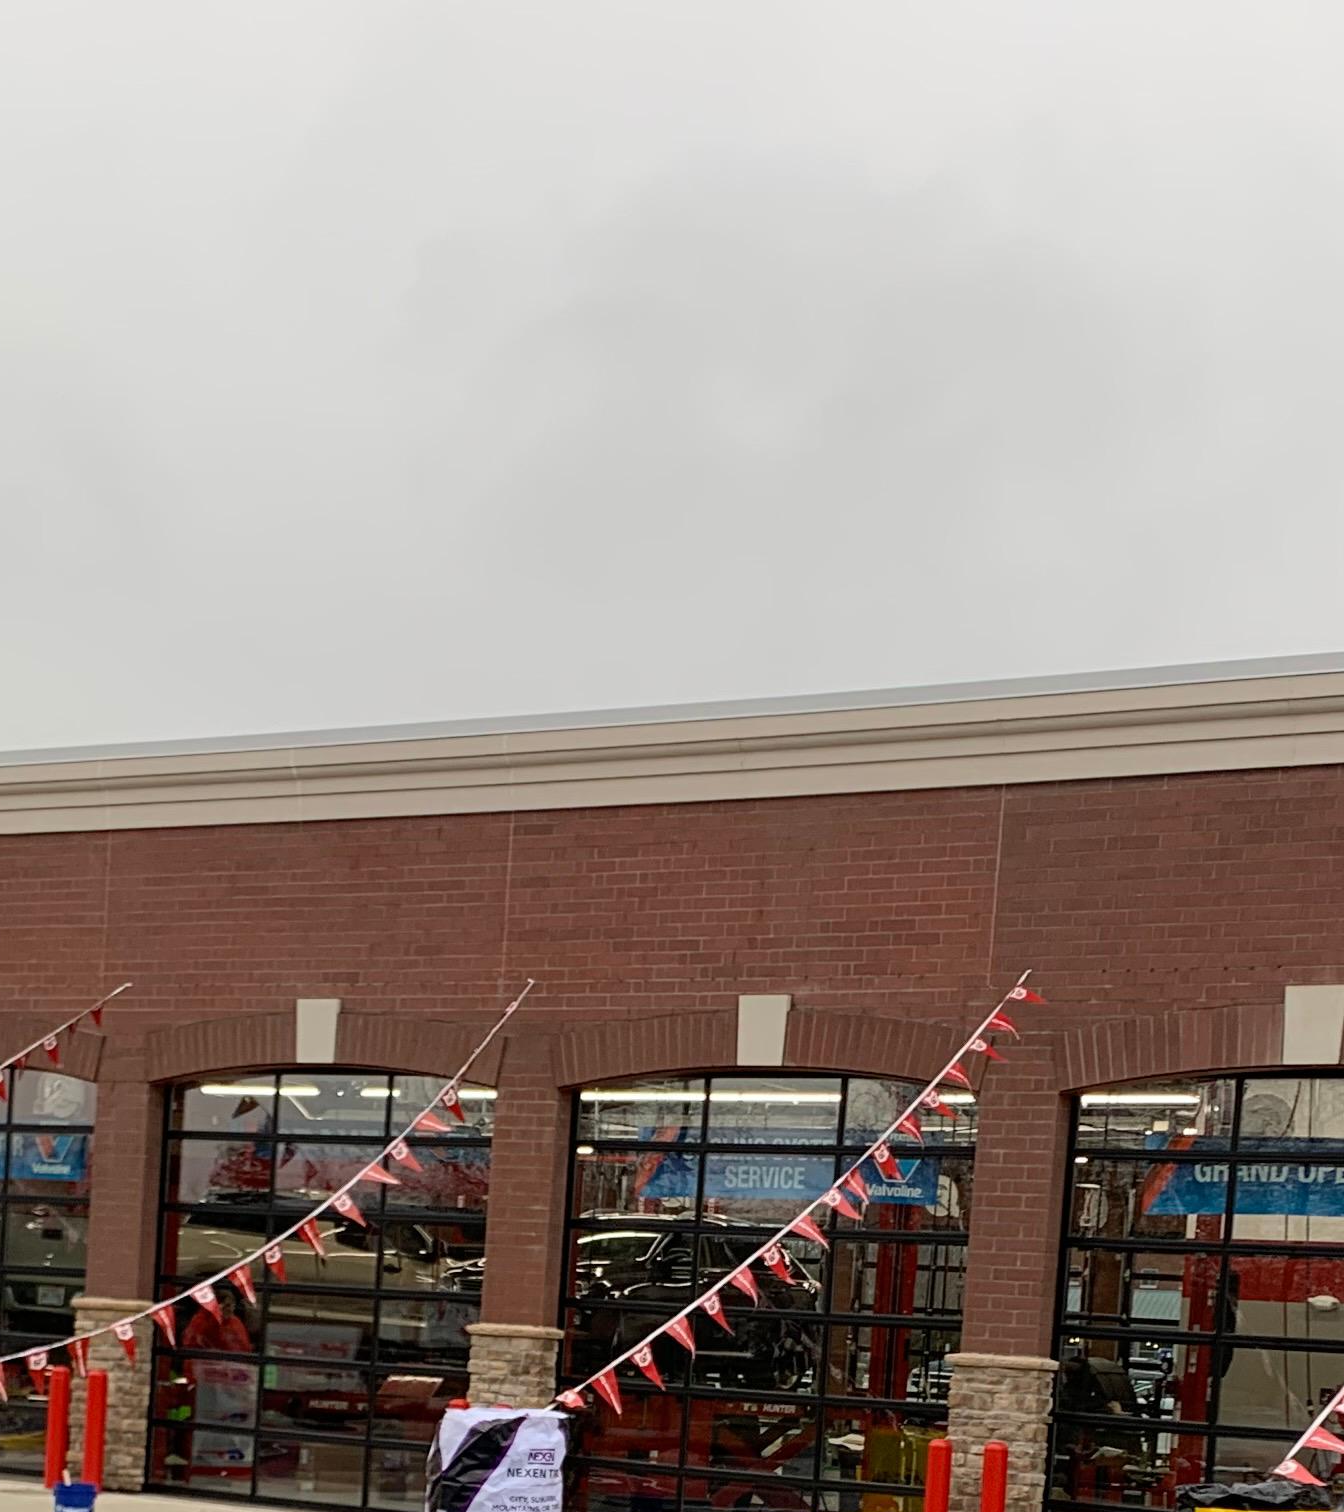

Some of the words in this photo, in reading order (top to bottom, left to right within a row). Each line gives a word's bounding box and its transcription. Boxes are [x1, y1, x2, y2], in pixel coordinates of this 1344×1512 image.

[683, 1137, 766, 1160] COLING
[724, 1165, 805, 1189] SERVICE
[1194, 1163, 1289, 1183] GRAND
[866, 1183, 924, 1198] Valvoline
[763, 1403, 796, 1414] HUNTER
[506, 1467, 546, 1478] NEXEN
